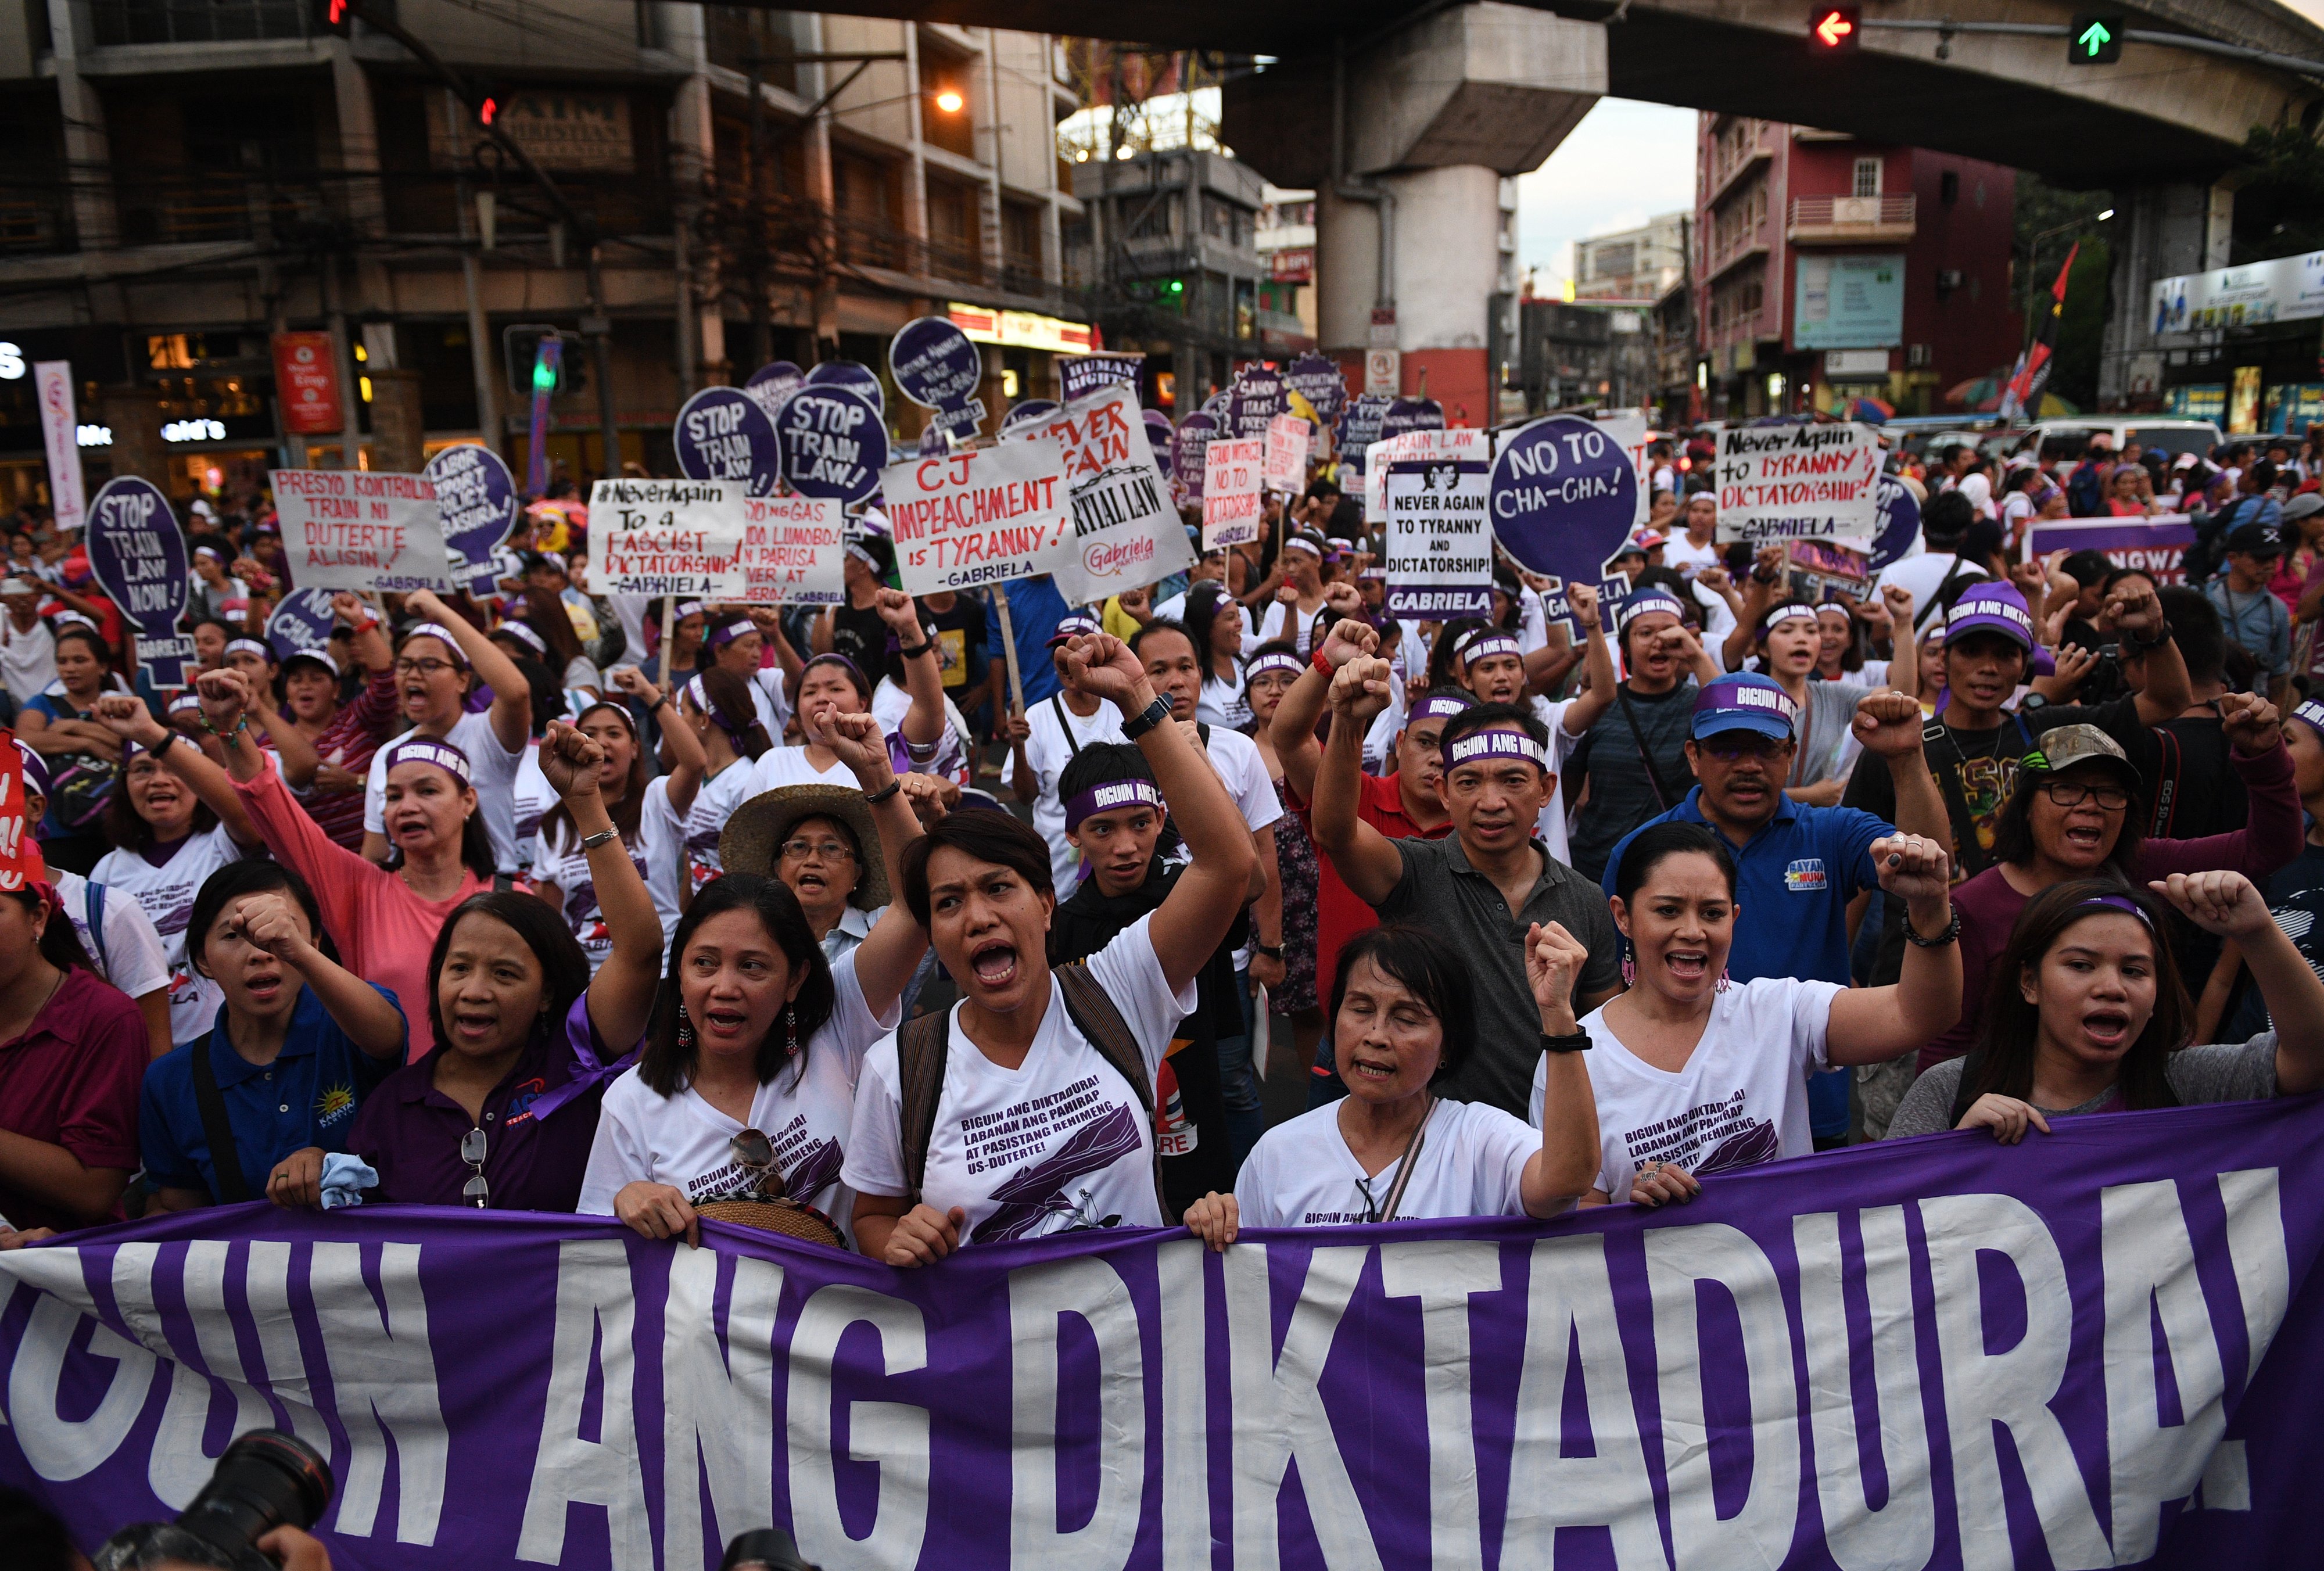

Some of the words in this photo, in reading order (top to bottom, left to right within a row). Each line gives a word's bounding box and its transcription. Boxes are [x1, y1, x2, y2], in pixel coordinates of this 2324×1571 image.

[1068, 359, 1138, 378] HUMAN
[686, 401, 747, 442] STOP
[792, 396, 866, 436] STOP
[694, 433, 752, 464] TRAIN
[784, 427, 860, 464] TRAIN
[1063, 428, 1129, 479] GAIN
[1385, 432, 1432, 451] TRAIN
[1726, 431, 1789, 455] Never
[1792, 426, 1854, 452] Again
[708, 458, 752, 480] LAW
[1508, 440, 1559, 480] NO
[1563, 431, 1605, 464] TO
[1720, 461, 1750, 482] to
[1760, 447, 1859, 478] TYRANNY
[275, 472, 346, 496] PRESYO
[790, 455, 868, 489] LAW!
[916, 452, 978, 492] CJ
[1214, 469, 1229, 490] NO
[1233, 468, 1248, 487] TO
[1494, 466, 1622, 519] CHA-CHA!
[1721, 466, 1877, 510] DICTATORSHIP!
[99, 492, 156, 529] STOP
[304, 497, 360, 519] TRAIN
[370, 503, 389, 521] NI
[790, 501, 826, 521] GAS
[890, 475, 1059, 544] IMPEACHMENT
[1073, 486, 1127, 539] RTIAL
[1129, 475, 1163, 520] LAW
[1394, 496, 1439, 510] NEVER
[1443, 496, 1484, 510] AGAIN
[618, 509, 647, 530] To
[659, 511, 673, 526] a
[1397, 519, 1414, 534] TO
[1419, 519, 1482, 534] TYRANNY
[103, 530, 164, 559] TRAIN
[304, 522, 407, 550] DUTERTE
[607, 531, 708, 554] FASCIST
[909, 549, 927, 566] IS
[930, 517, 1066, 568] TYRANNY!
[1429, 540, 1450, 552] AND
[760, 548, 817, 566] PARUSA
[1089, 536, 1154, 569] Gabriela
[1388, 557, 1490, 573] DICTATORSHIP!
[120, 558, 167, 582] LAW
[786, 569, 806, 582] AT
[125, 580, 182, 613] NOW!
[1389, 591, 1491, 611] GABRIELA
[1548, 582, 1625, 617] GAELA
[1978, 600, 2002, 615] ANG
[1483, 639, 1500, 655] ANG
[1263, 654, 1280, 668] ANG
[1429, 699, 1465, 716] BIGUIN
[1737, 687, 1777, 710] BIGUIN
[1452, 734, 1489, 762] BIGUIN
[1491, 733, 1518, 754] ANG
[1519, 736, 1545, 765] DIKTA
[1094, 783, 1135, 808] BIGUIN
[1137, 783, 1152, 802] ANG
[2161, 779, 2174, 804] EOS
[2158, 805, 2169, 819] 5D
[1789, 860, 1824, 873] BAYAN
[1799, 872, 1824, 883] MUNA
[961, 1110, 1005, 1132] BIGUIN
[1006, 1102, 1031, 1119] ANG
[1032, 1074, 1100, 1112] DIKTADURA!
[964, 1120, 1020, 1147] LABANAN
[1022, 1112, 1047, 1129] ANG
[1049, 1089, 1100, 1122] PAHIRAP
[965, 1147, 980, 1161] AT
[982, 1127, 1052, 1157] PASISTANG
[1052, 1100, 1114, 1133] REHIMENG
[1624, 1121, 1665, 1144] BIGUIN
[1666, 1113, 1688, 1132] ANG
[1701, 1117, 1757, 1144] REHIMENG
[774, 1129, 808, 1159] HIRAP
[1628, 1132, 1682, 1158] LABANAN
[967, 1141, 1047, 1175] US-DUTERTE!
[688, 1164, 727, 1192] BIGUIN
[1304, 1212, 1341, 1224] BIGUIN
[515, 1238, 931, 1571] ANG
[1009, 1166, 2290, 1571] DIKTADURA!
